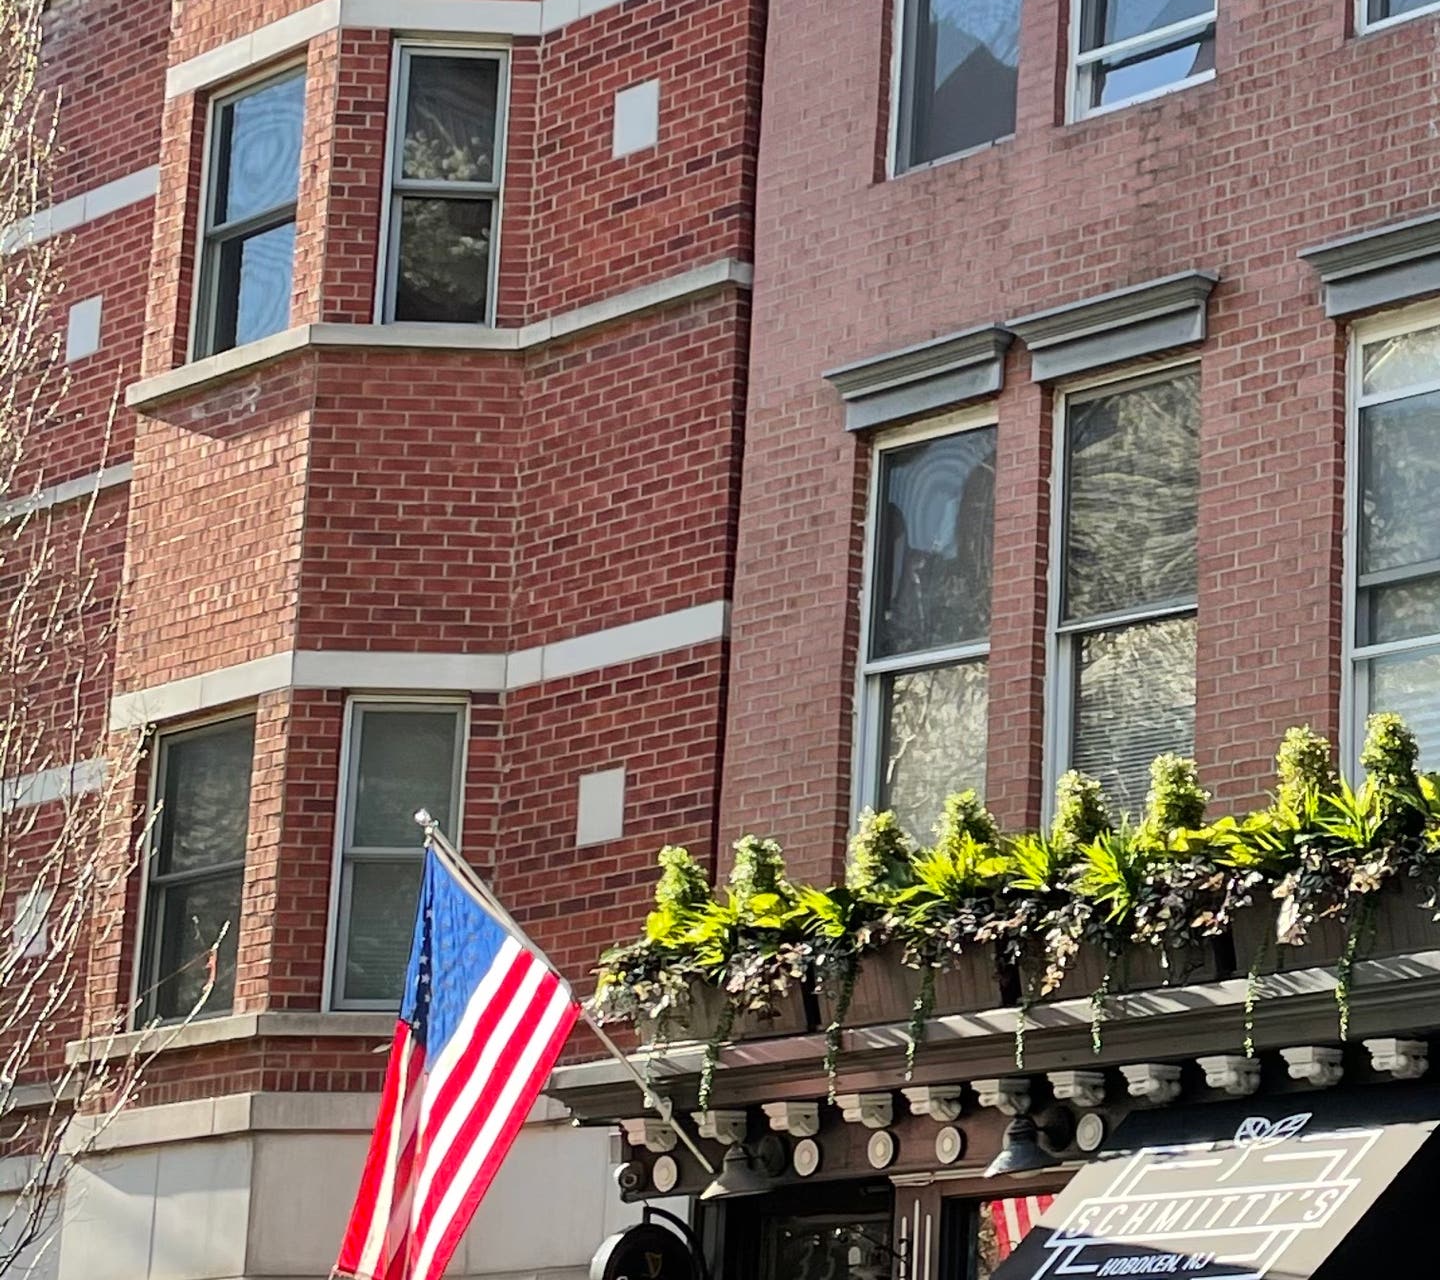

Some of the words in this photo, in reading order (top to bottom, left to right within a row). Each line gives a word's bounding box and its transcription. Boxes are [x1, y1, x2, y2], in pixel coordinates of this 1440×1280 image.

[1067, 1187, 1342, 1238] SCHMITTY'S
[1097, 1254, 1178, 1277] HOBOKEN,
[1181, 1251, 1216, 1271] NJ
